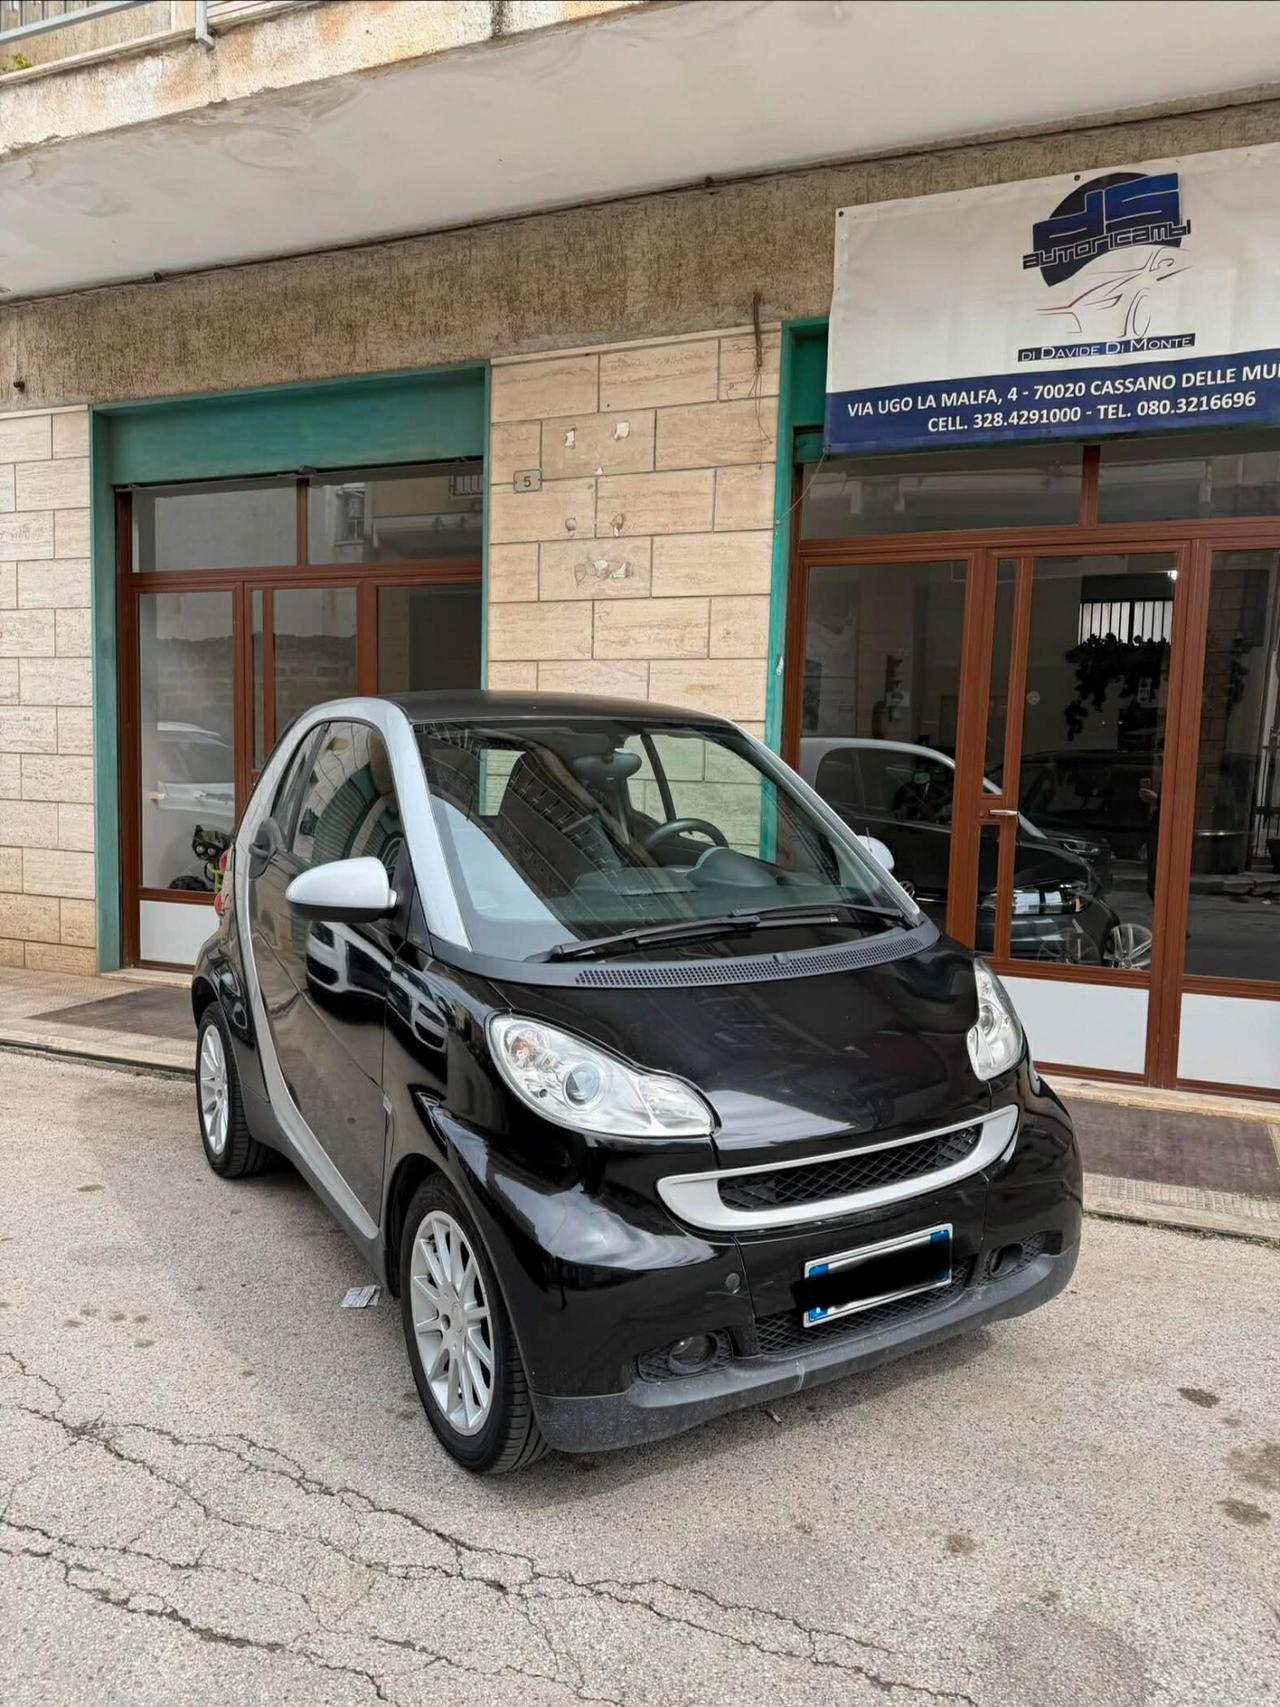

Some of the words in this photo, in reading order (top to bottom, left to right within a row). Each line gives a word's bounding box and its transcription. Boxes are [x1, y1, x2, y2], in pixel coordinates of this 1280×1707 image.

[847, 403, 874, 417] VIA
[878, 397, 913, 414] UGO
[917, 394, 937, 410] LA
[941, 389, 1003, 407] MALFA,
[1007, 387, 1018, 401] 4
[1033, 382, 1086, 400] 70020
[1090, 375, 1176, 396] CASSANO
[1181, 368, 1237, 388] DELLE
[928, 415, 969, 432] CELL.
[973, 407, 1081, 428] 328.4291000
[1097, 404, 1132, 420] TEL.
[1137, 391, 1257, 417] 080.3216696
[523, 475, 532, 488] 5
